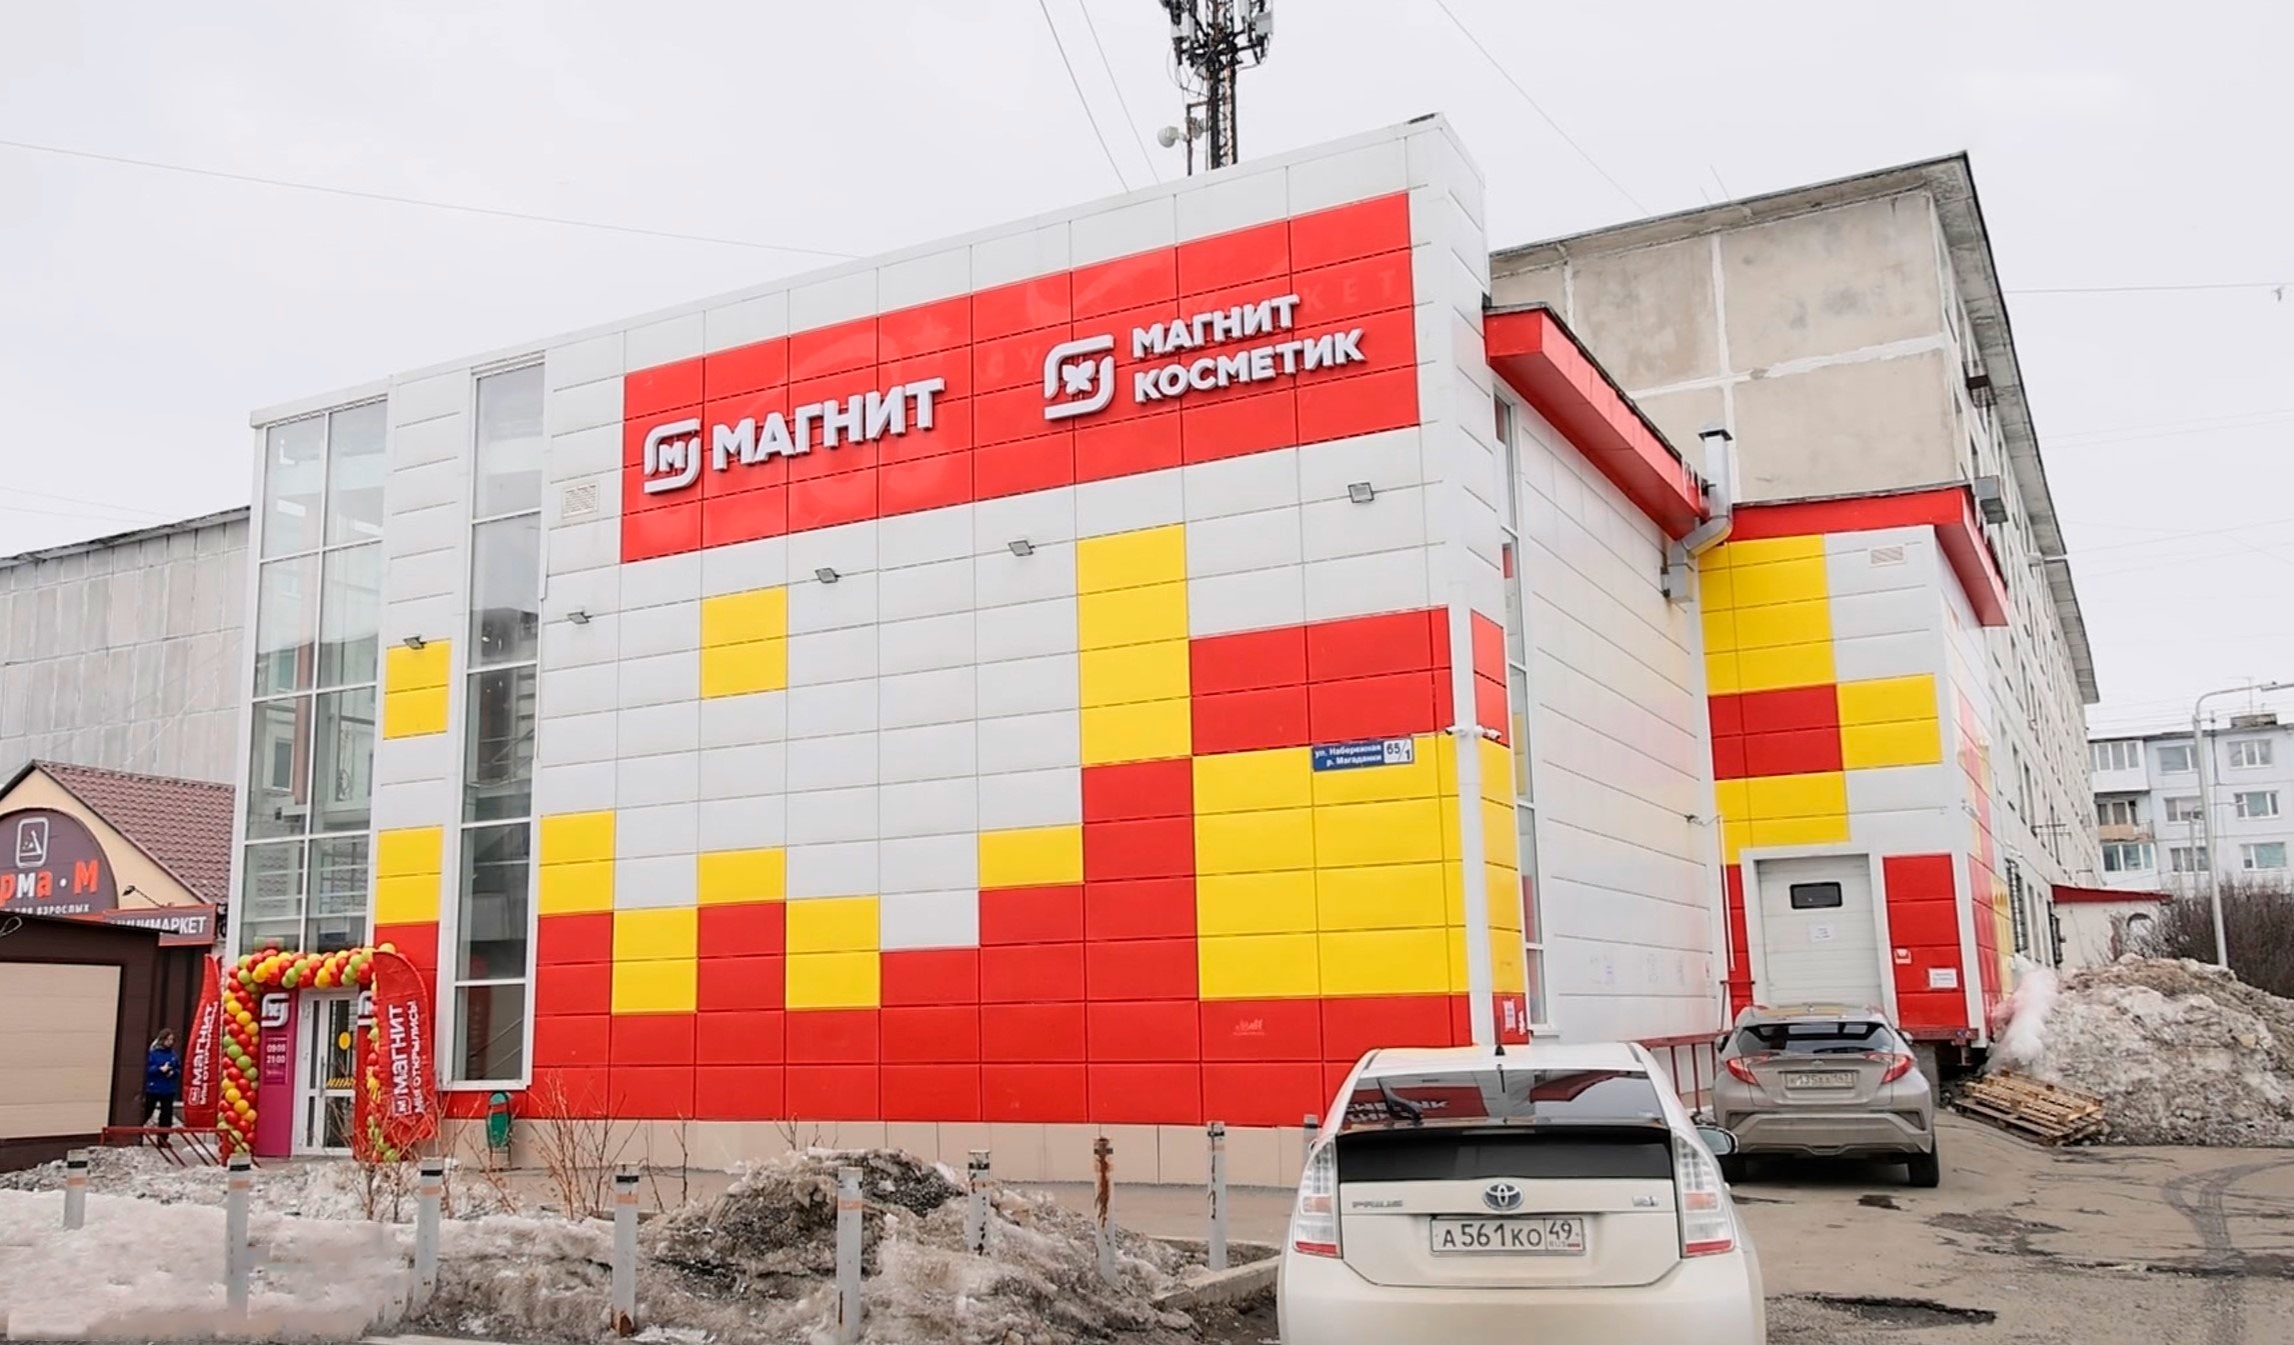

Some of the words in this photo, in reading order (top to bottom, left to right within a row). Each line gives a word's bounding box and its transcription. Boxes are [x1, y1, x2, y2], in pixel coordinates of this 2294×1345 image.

[1132, 294, 1300, 359] МАГНИТ
[1133, 328, 1366, 401] КОСМЕТИК
[712, 377, 945, 471] МАГНИТ
[1329, 745, 1382, 756] Набережная
[388, 1004, 409, 1095] МАГНИТ
[1549, 1220, 1572, 1240] 49
